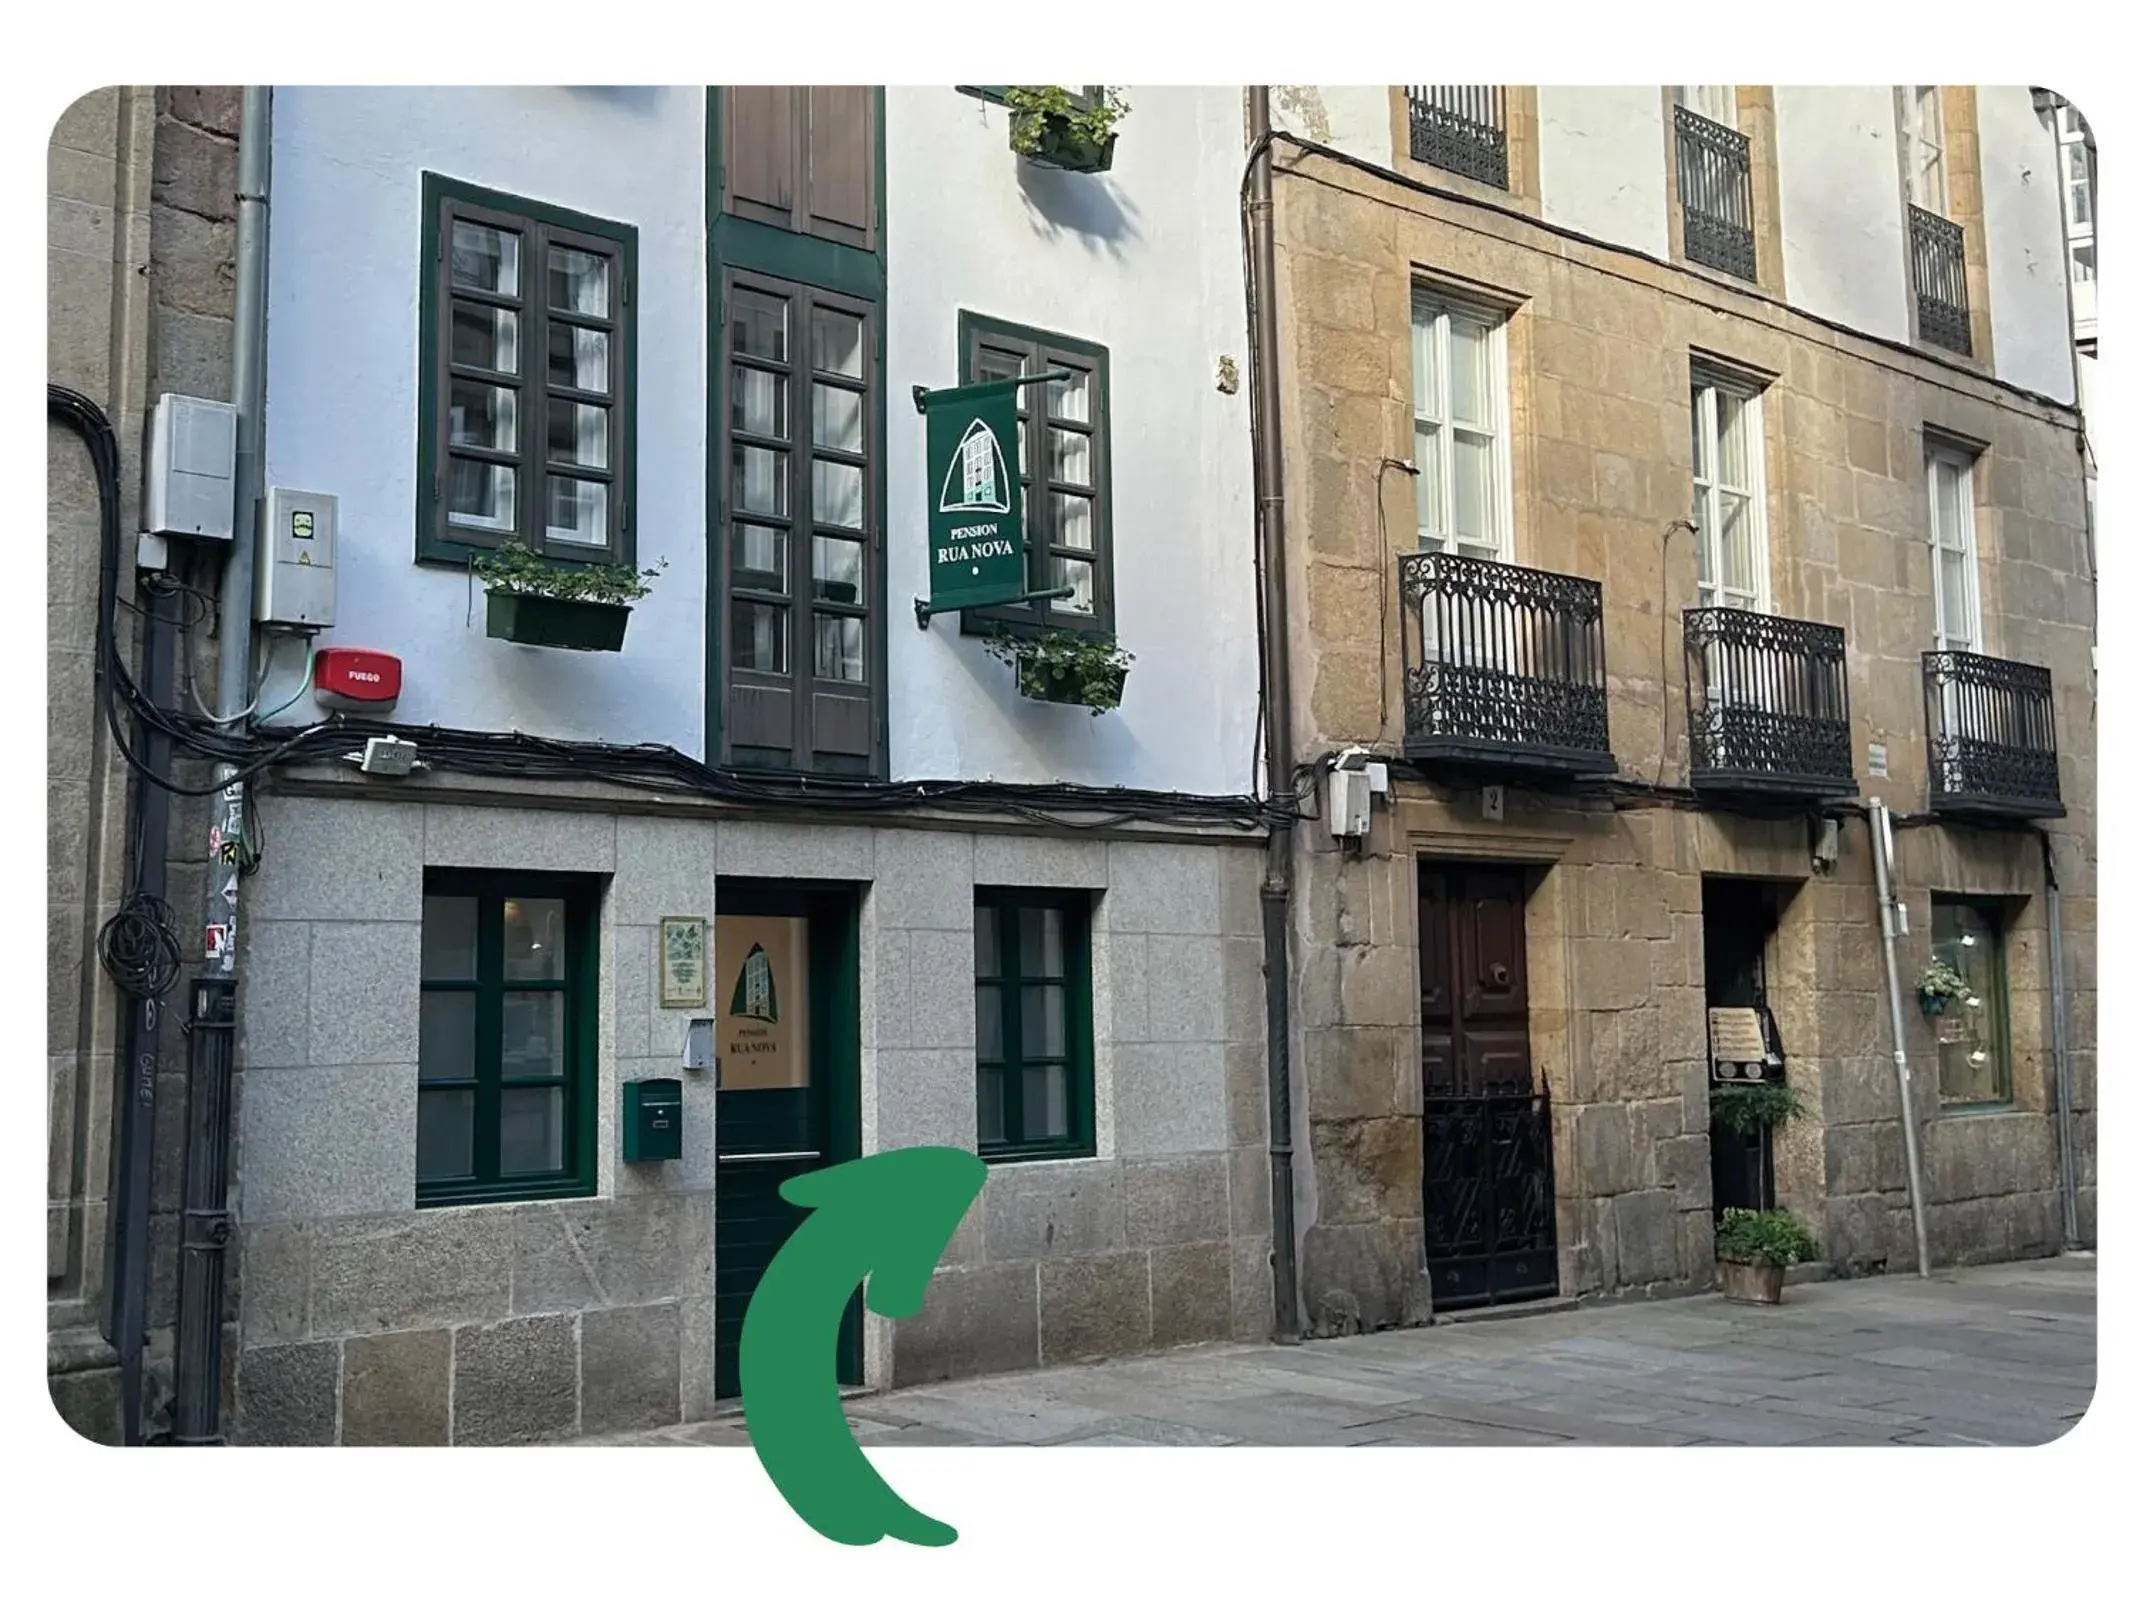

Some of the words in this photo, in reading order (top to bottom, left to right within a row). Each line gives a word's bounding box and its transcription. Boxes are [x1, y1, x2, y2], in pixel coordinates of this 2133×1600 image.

[950, 523, 998, 540] PENSION
[938, 546, 969, 563] RUA
[971, 540, 1014, 559] NOVA
[349, 668, 381, 683] FUEGO
[1489, 789, 1498, 811] 2
